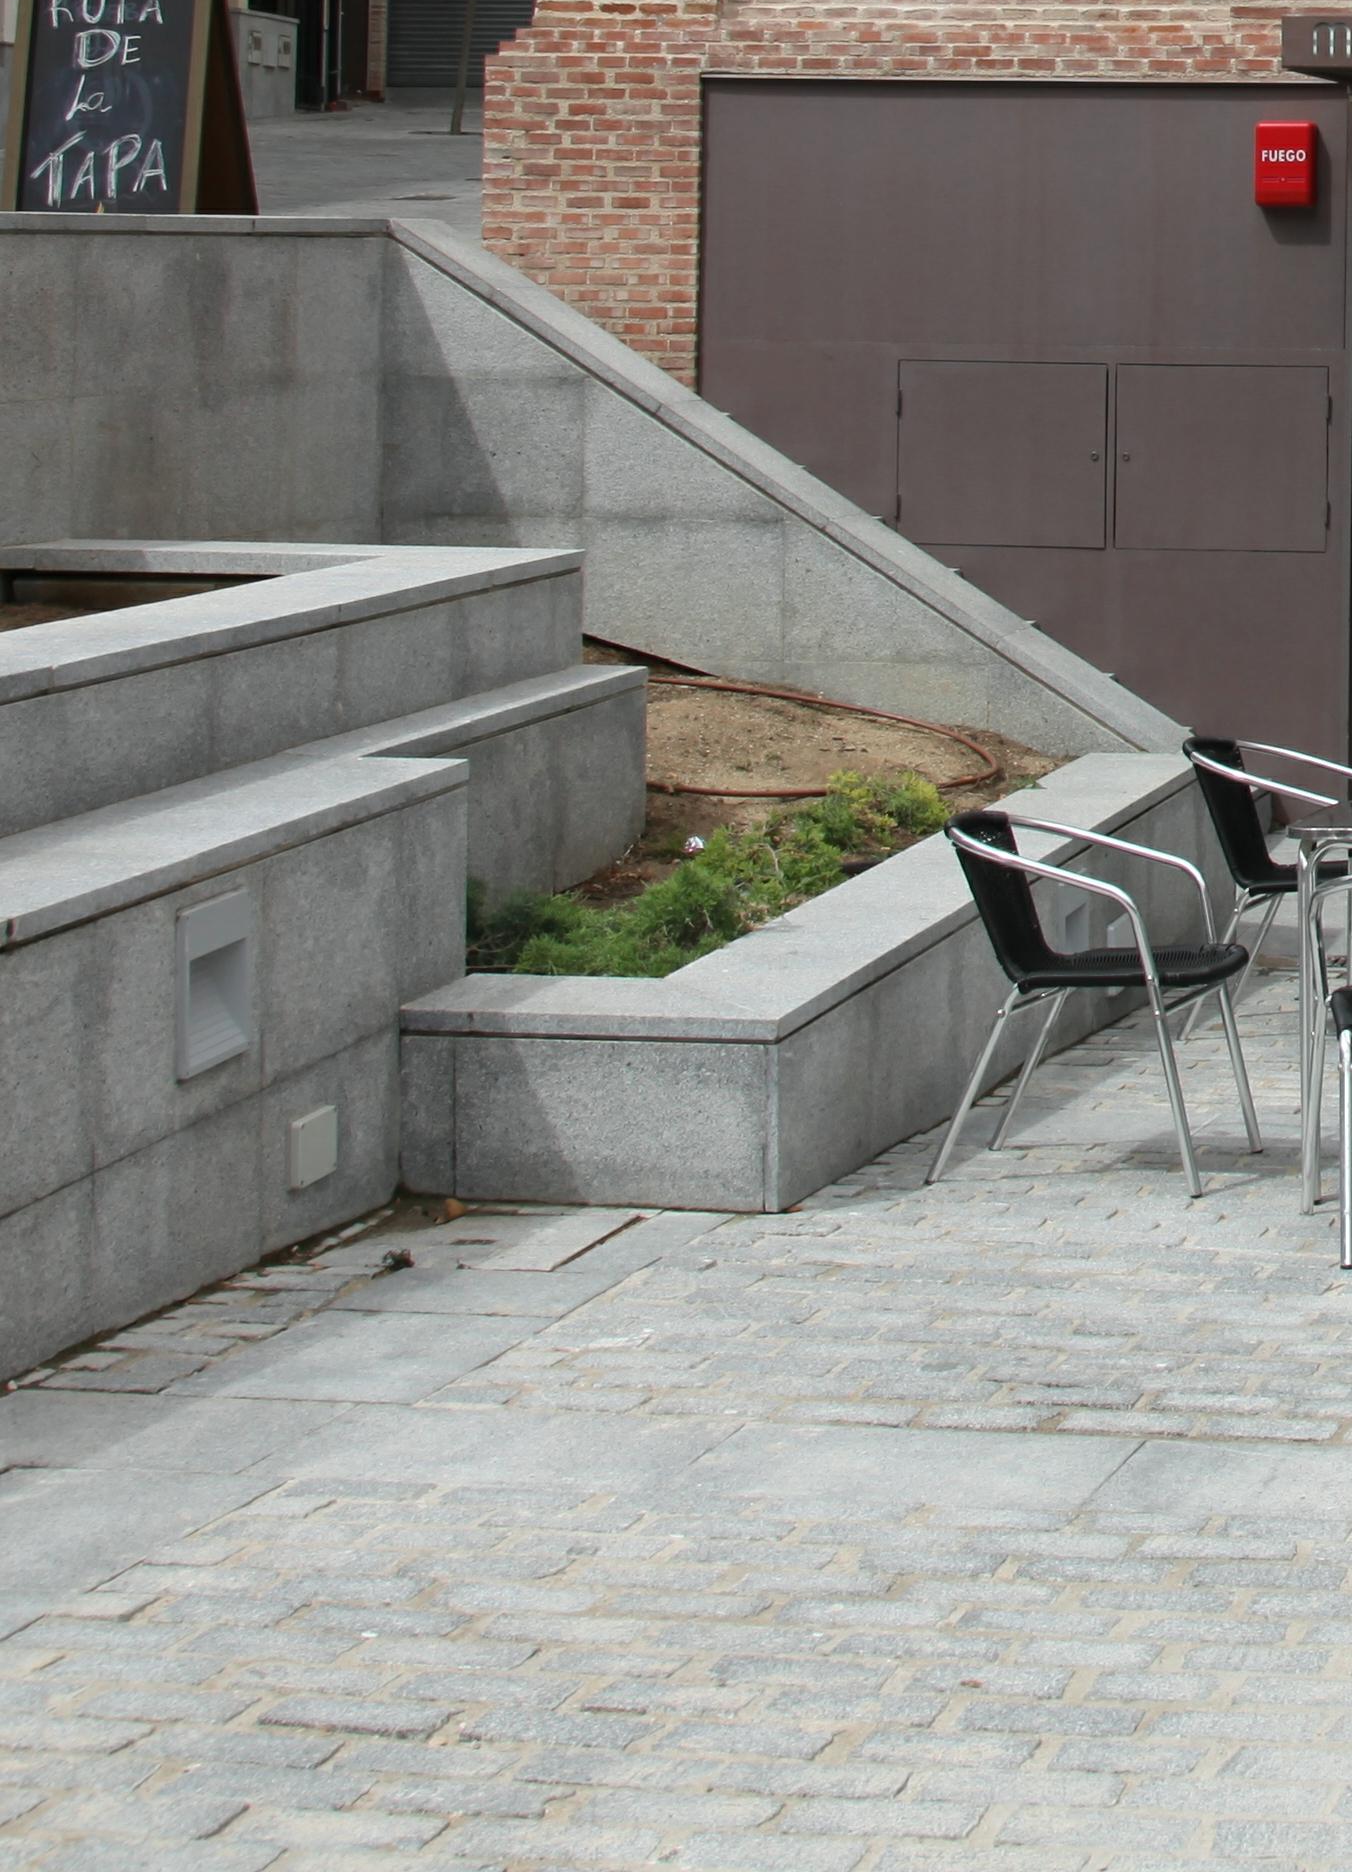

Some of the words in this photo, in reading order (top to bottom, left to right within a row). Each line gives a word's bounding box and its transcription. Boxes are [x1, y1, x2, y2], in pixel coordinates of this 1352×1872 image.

[75, 29, 142, 67] DE
[65, 74, 112, 121] La
[30, 130, 168, 209] TAPA
[1261, 149, 1307, 162] FUEGO
